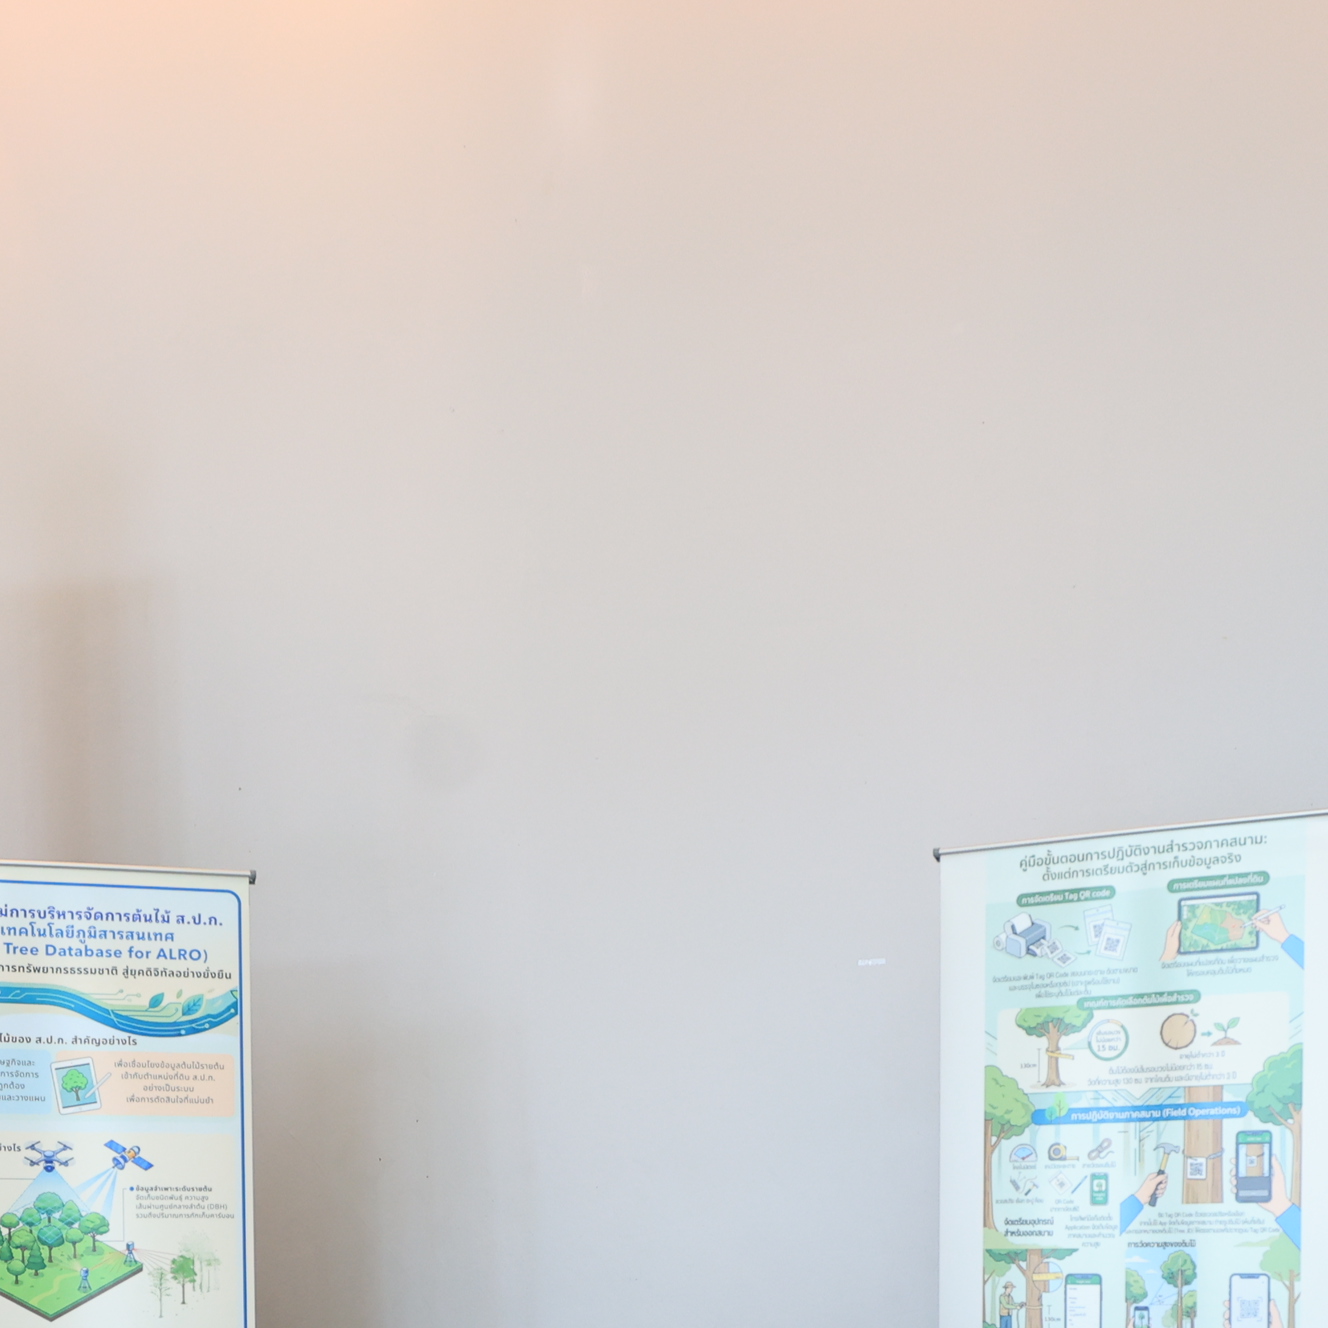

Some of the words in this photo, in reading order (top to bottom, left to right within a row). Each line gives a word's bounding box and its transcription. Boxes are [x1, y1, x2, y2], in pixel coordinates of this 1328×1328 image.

[176, 913, 224, 927] ส.ป.ก.
[3, 942, 39, 956] Tree
[45, 943, 122, 958] Database
[128, 946, 151, 959] for
[156, 947, 209, 963] ALRO)
[1163, 1107, 1186, 1119] (Field
[1187, 1105, 1241, 1118] Operations)
